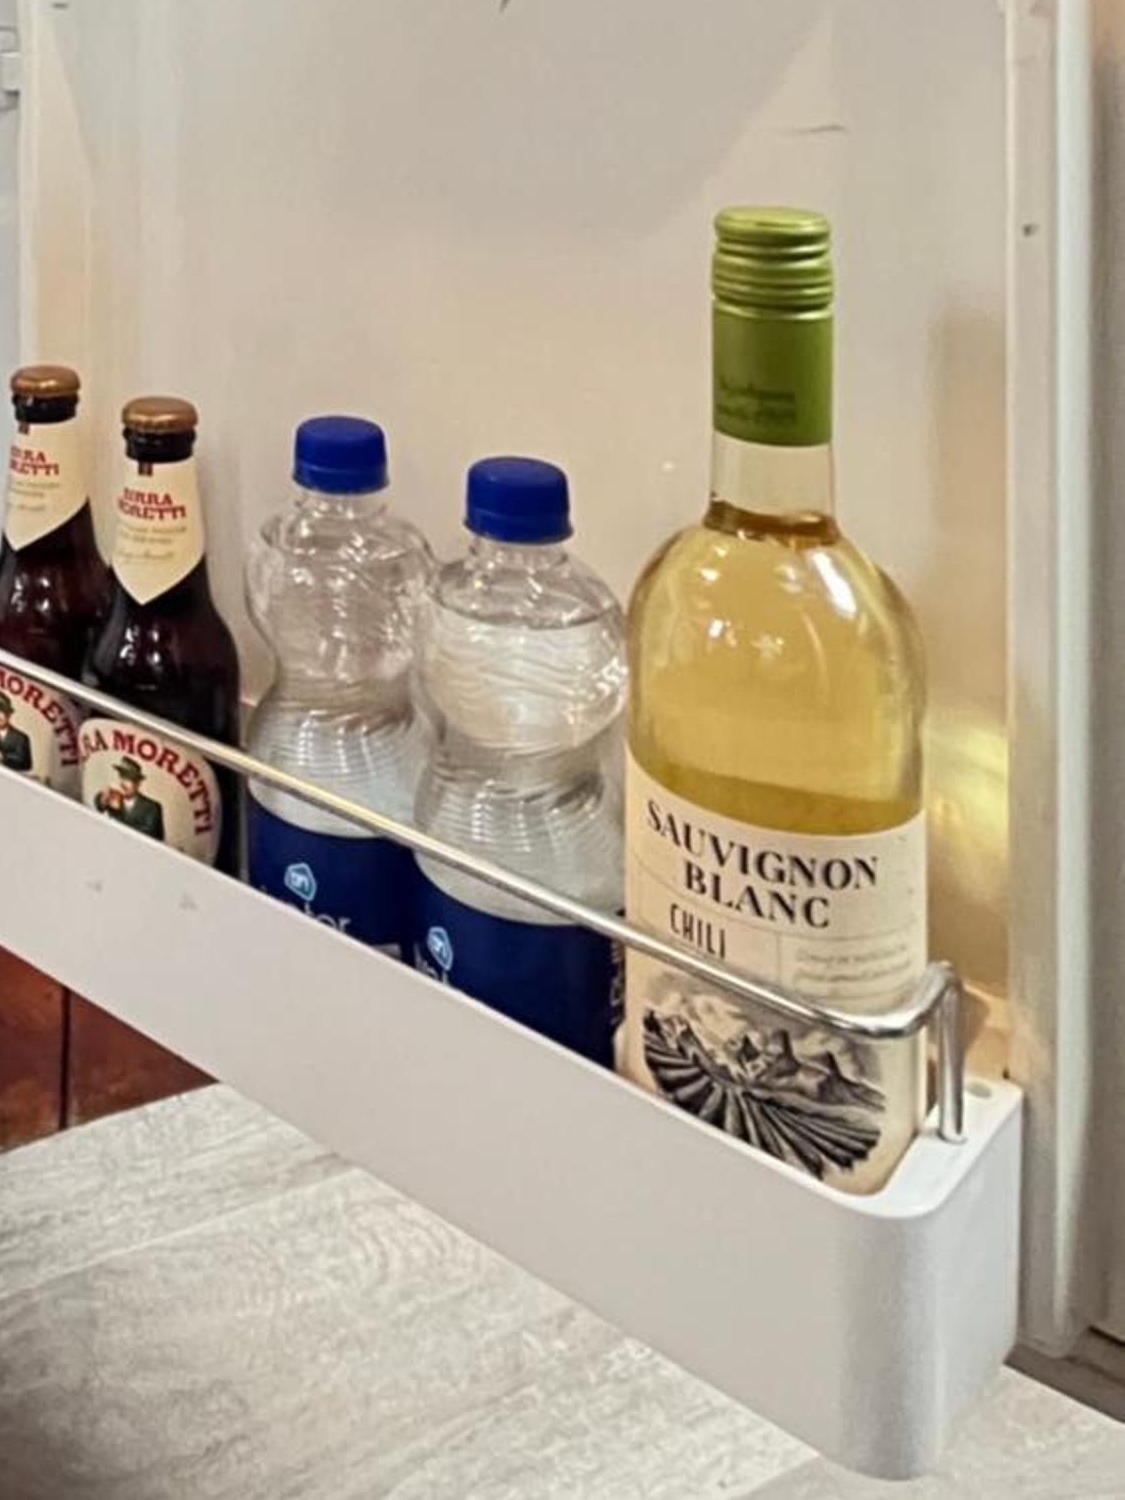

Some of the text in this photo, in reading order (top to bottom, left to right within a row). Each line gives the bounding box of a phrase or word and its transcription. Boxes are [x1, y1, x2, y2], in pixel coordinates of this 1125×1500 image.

[112, 729, 213, 835] MORETTI
[647, 800, 878, 891] SAUVIGNON
[670, 903, 725, 960] CHILI
[685, 859, 830, 929] BLANC
